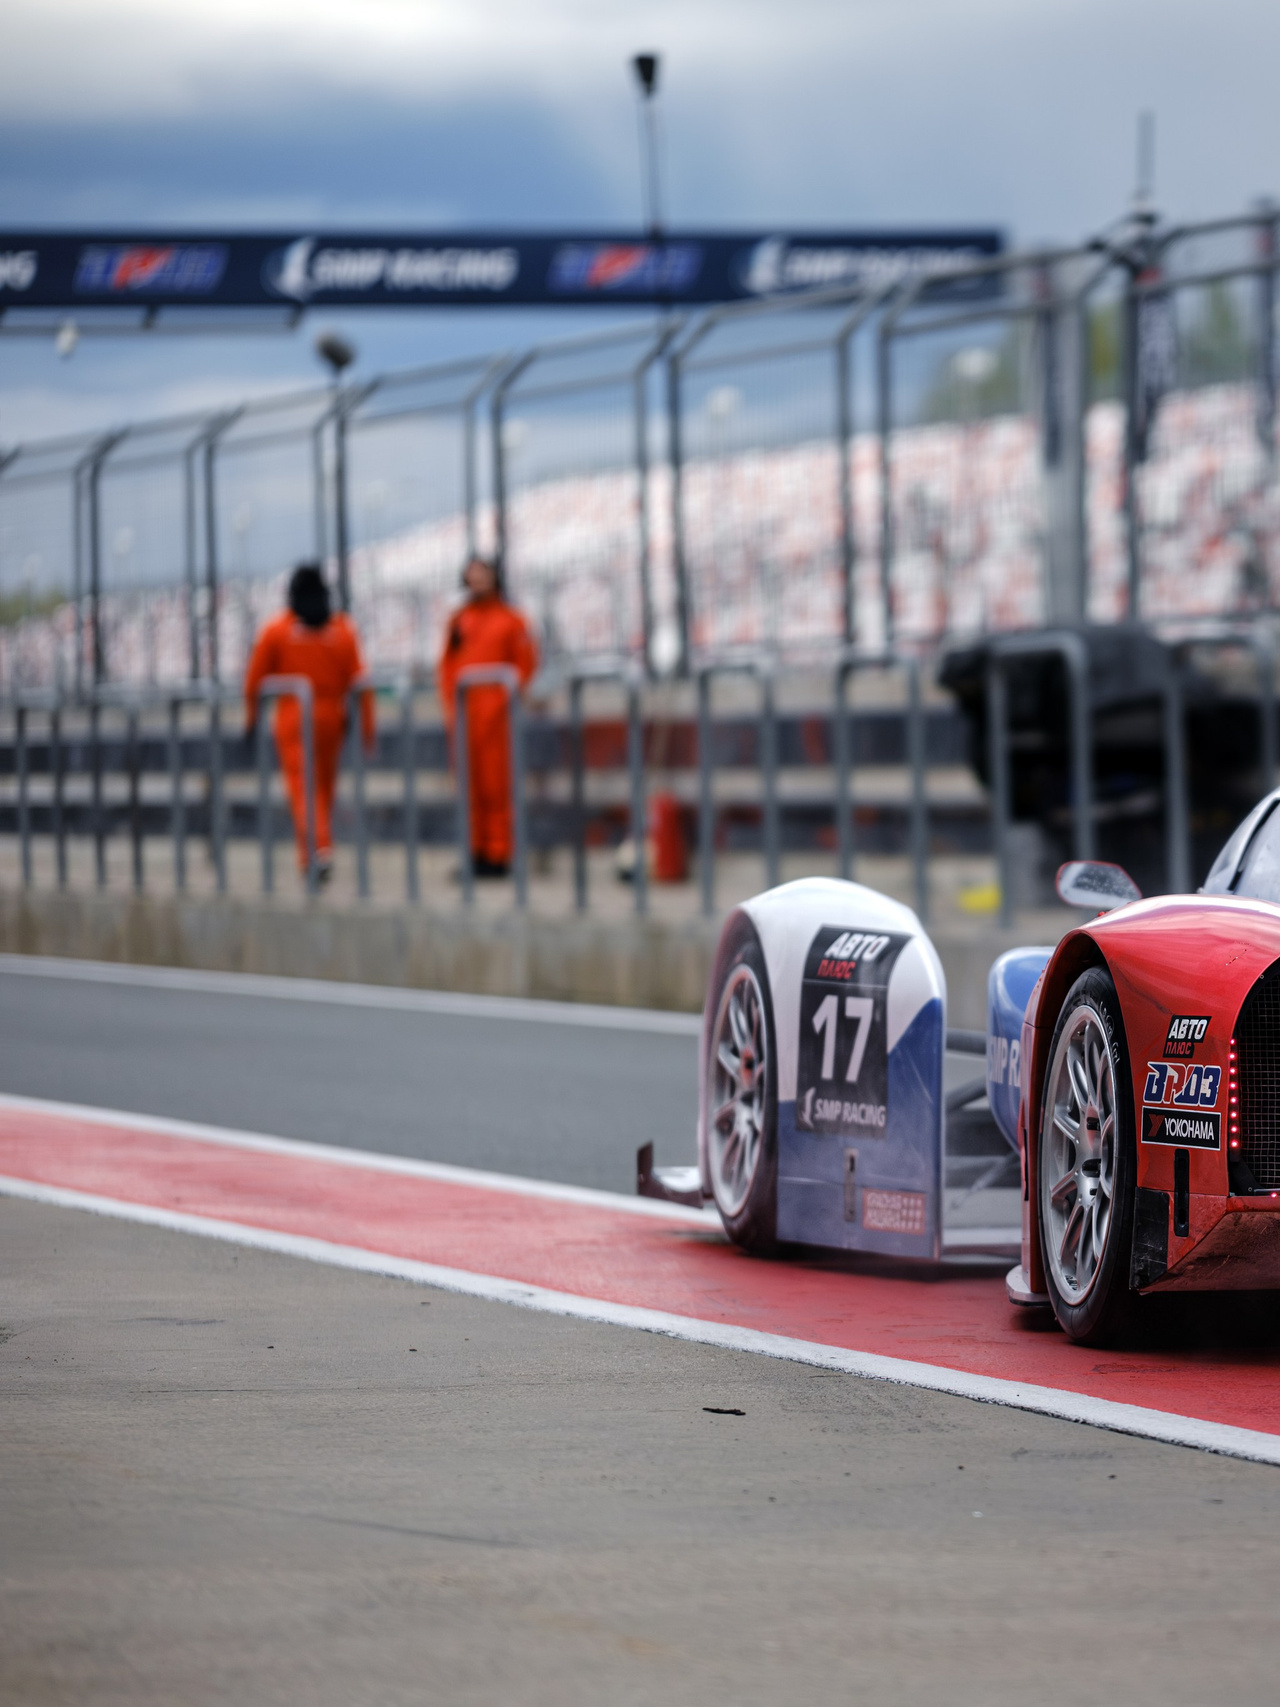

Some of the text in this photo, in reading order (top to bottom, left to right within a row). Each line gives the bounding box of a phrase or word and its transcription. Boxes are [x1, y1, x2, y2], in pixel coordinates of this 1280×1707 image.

[824, 932, 890, 961] АВТО
[812, 994, 874, 1083] 17
[1168, 1019, 1208, 1040] АВТО
[1165, 1041, 1192, 1055] ПЛЮС
[814, 1098, 886, 1128] SMP RACING
[1165, 1117, 1215, 1141] YOKOHAMA
